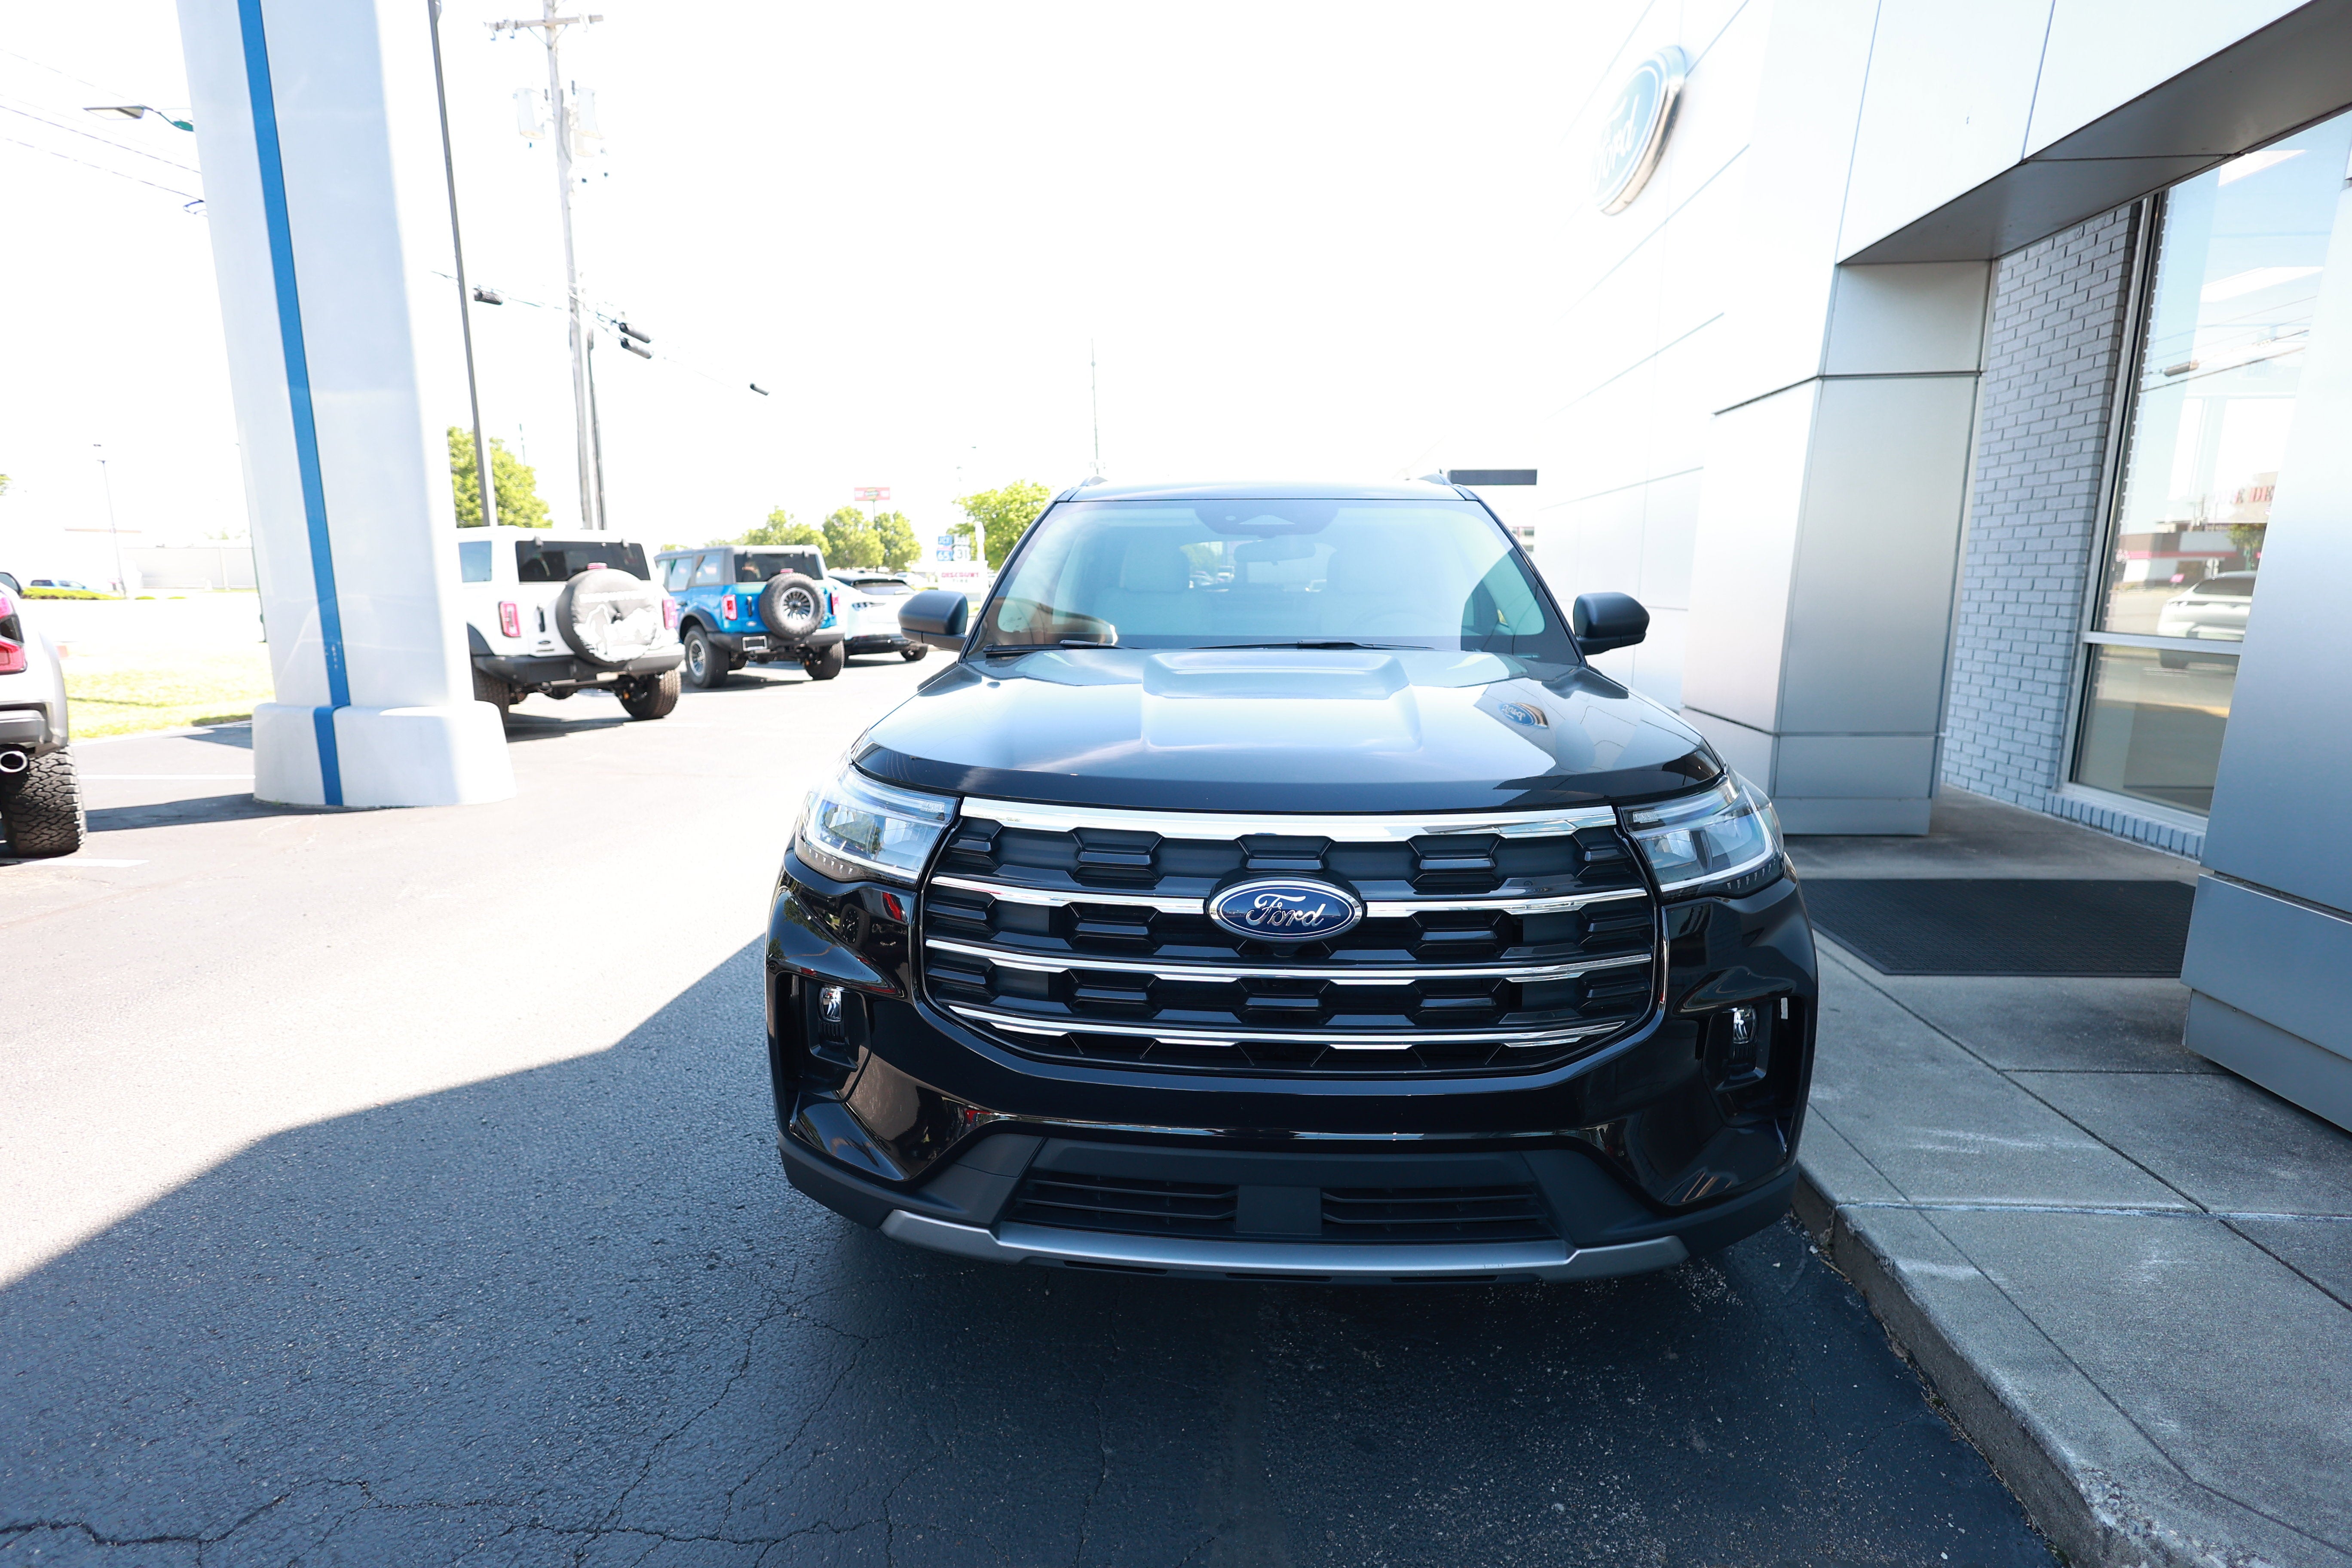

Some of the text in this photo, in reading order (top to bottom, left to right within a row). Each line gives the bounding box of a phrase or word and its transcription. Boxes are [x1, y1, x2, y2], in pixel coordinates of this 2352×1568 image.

[937, 551, 950, 560] 65
[956, 549, 968, 559] 31
[1245, 893, 1326, 927] Ford
